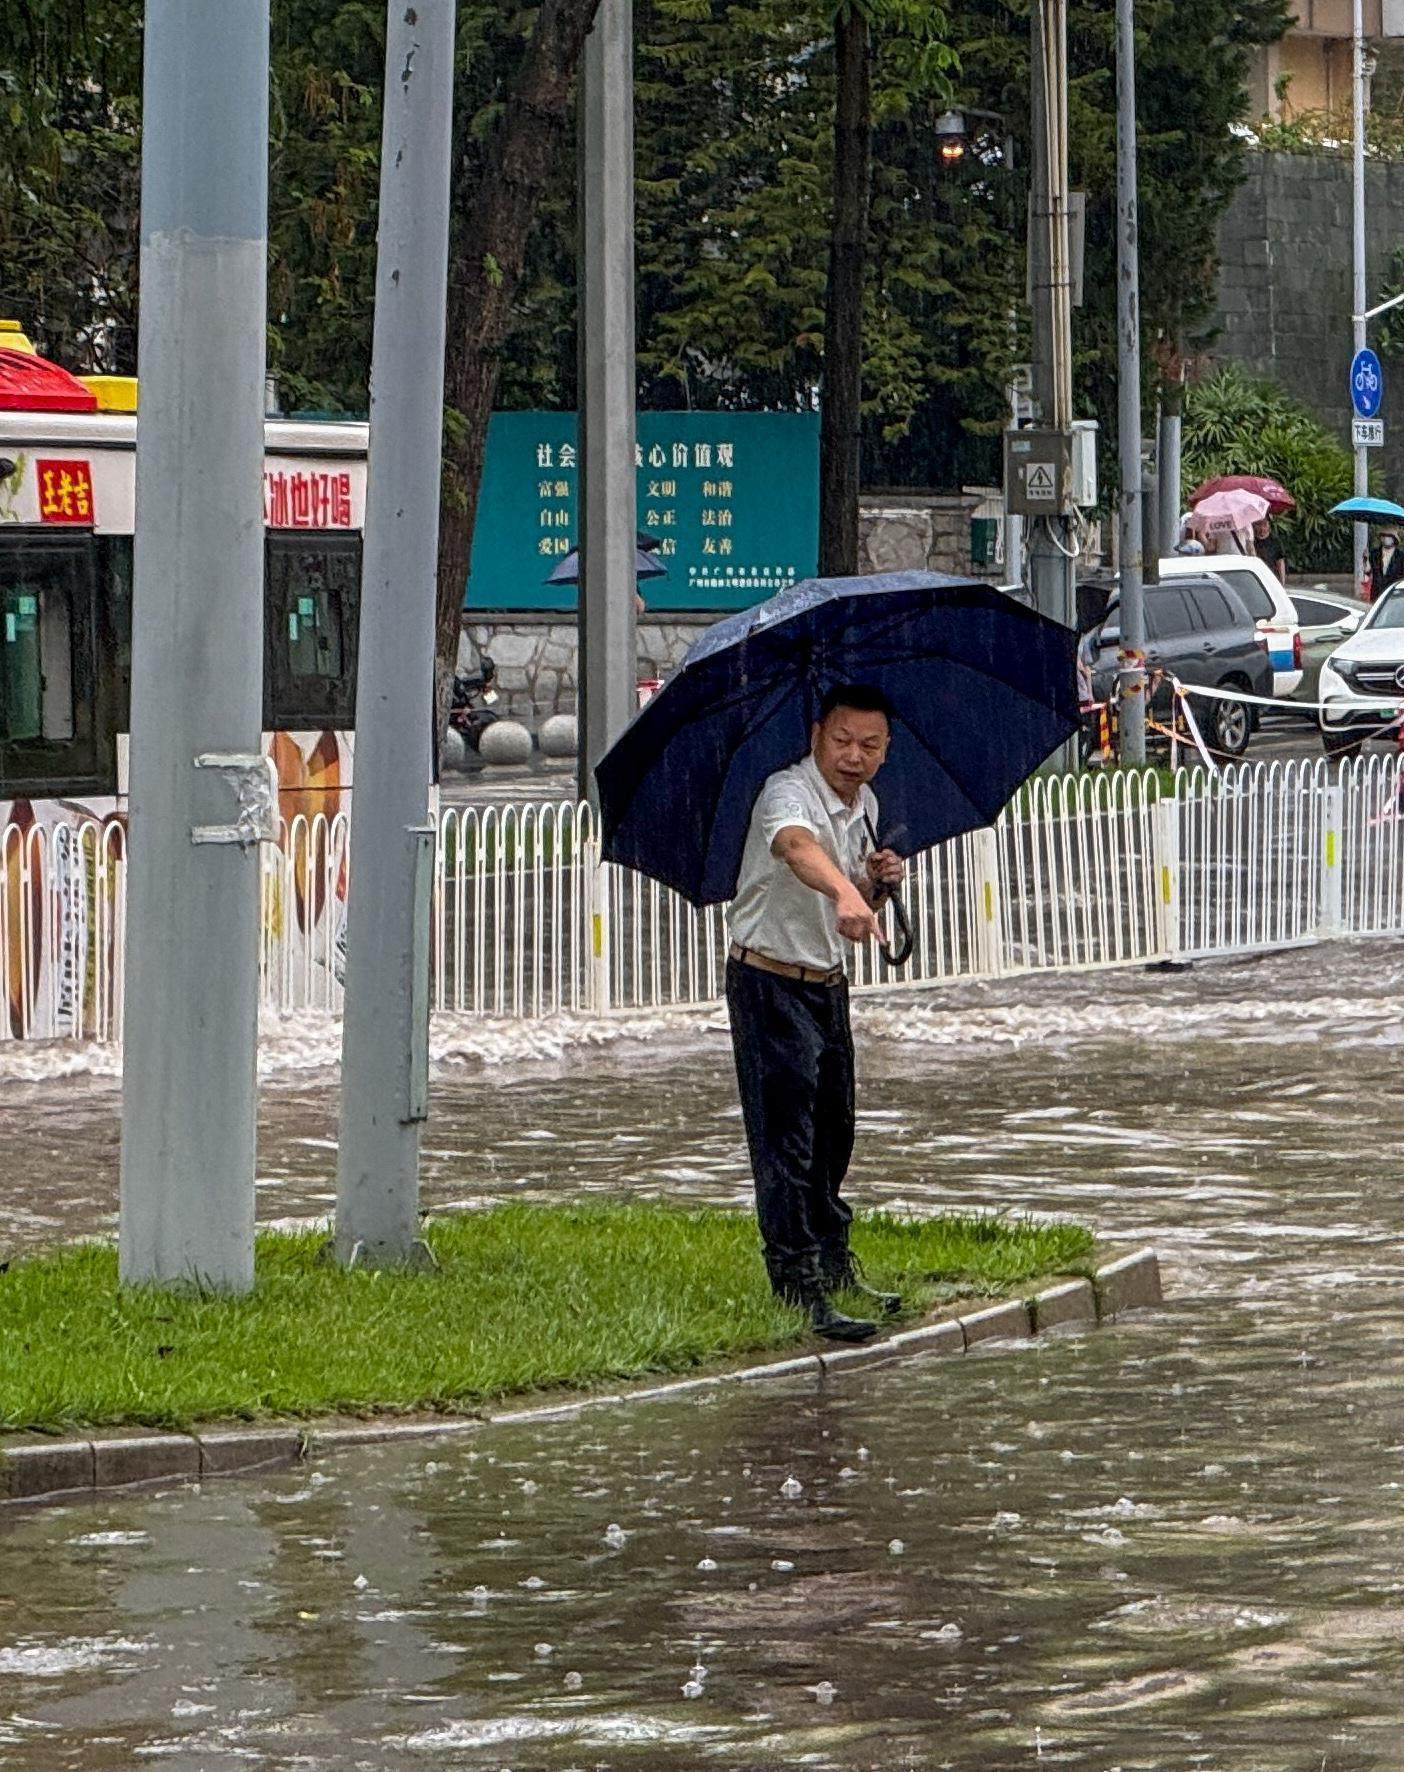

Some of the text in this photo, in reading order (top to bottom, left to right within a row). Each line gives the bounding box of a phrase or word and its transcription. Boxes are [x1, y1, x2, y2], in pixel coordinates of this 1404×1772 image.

[42, 470, 89, 516] 王老吉
[538, 480, 733, 498] 富强 文明 和谐
[263, 471, 351, 527] 冰也好喝
[540, 509, 732, 527] 自由 公正 法治
[538, 537, 569, 555] 爱国
[702, 537, 732, 555] 友善
